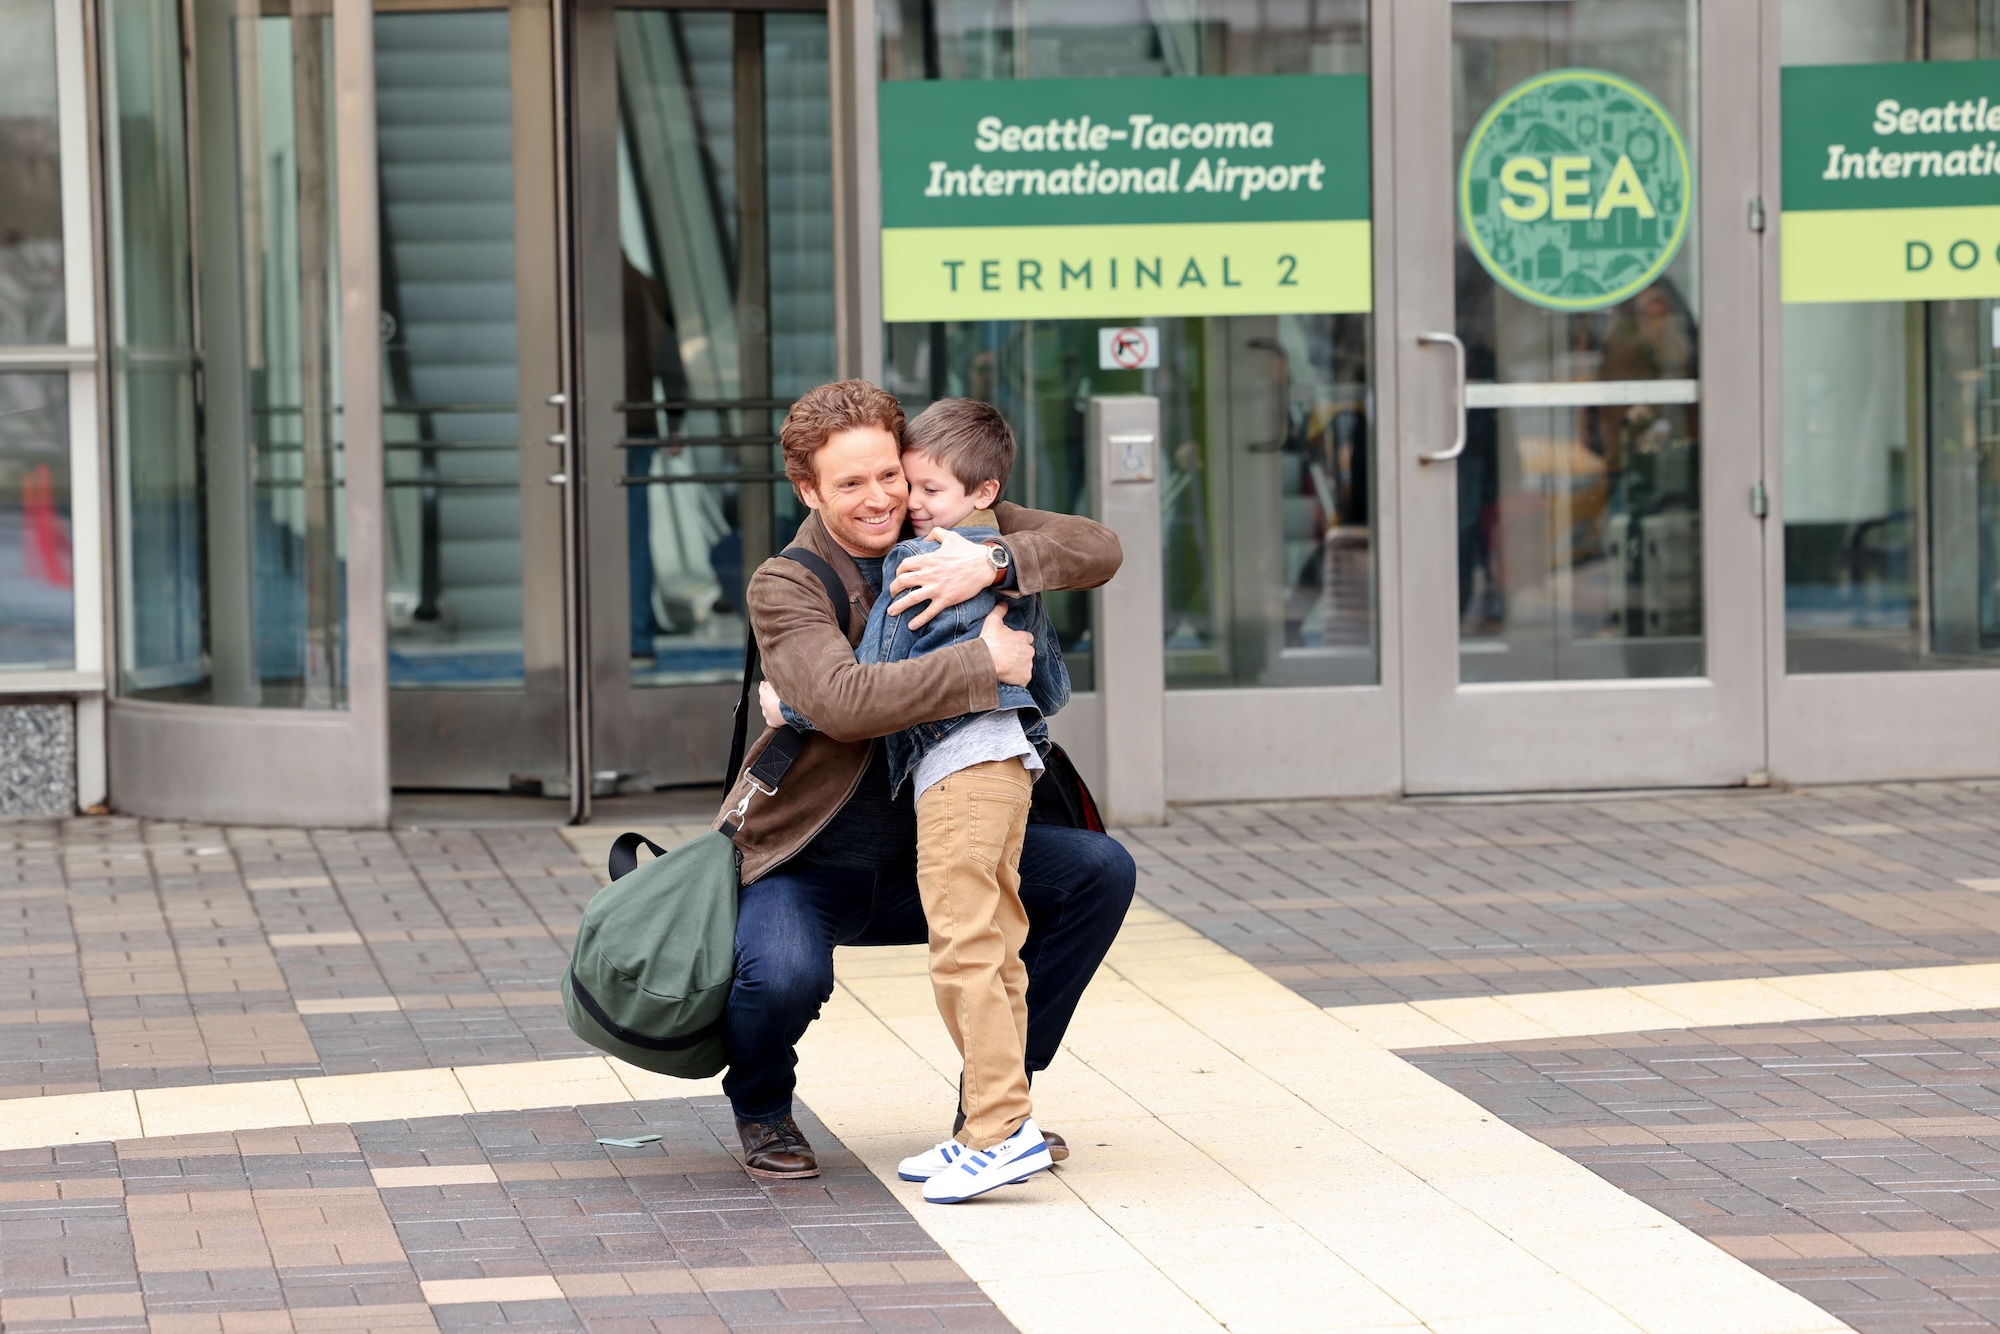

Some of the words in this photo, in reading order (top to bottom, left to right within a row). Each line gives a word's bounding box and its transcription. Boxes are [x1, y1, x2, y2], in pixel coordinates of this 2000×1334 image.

[974, 114, 1274, 153] Seattle-Tacoma
[924, 159, 1181, 198] International
[1183, 157, 1326, 201] Airport
[1499, 153, 1657, 222] SEA
[942, 255, 1243, 292] TERMINAL
[1276, 254, 1299, 287] 2
[1905, 239, 2000, 273] DO
